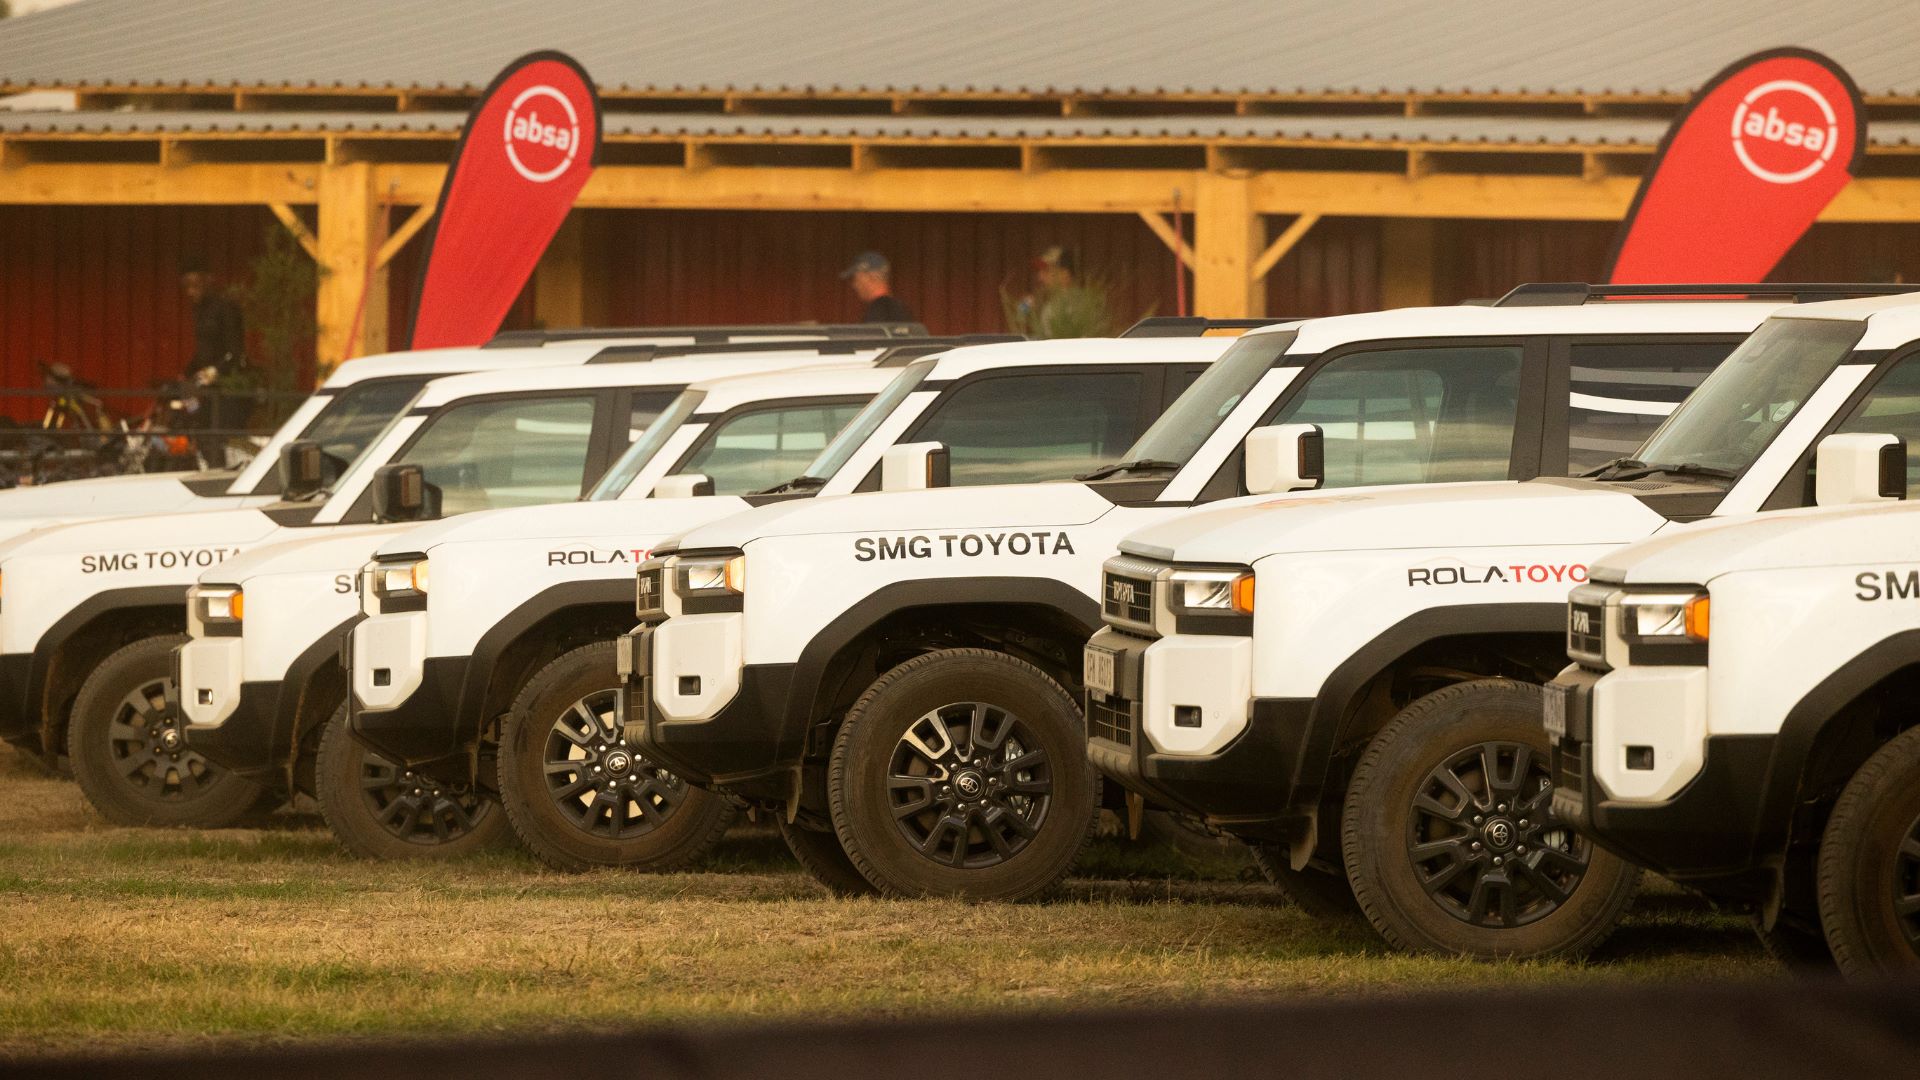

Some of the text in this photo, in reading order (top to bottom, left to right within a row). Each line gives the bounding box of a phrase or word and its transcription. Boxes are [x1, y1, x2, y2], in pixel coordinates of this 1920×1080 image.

[513, 111, 571, 151] absa
[1744, 106, 1825, 151] absa
[854, 531, 1075, 562] SMG TOYOTA
[81, 553, 138, 573] SMG
[1855, 570, 1920, 601] SM
